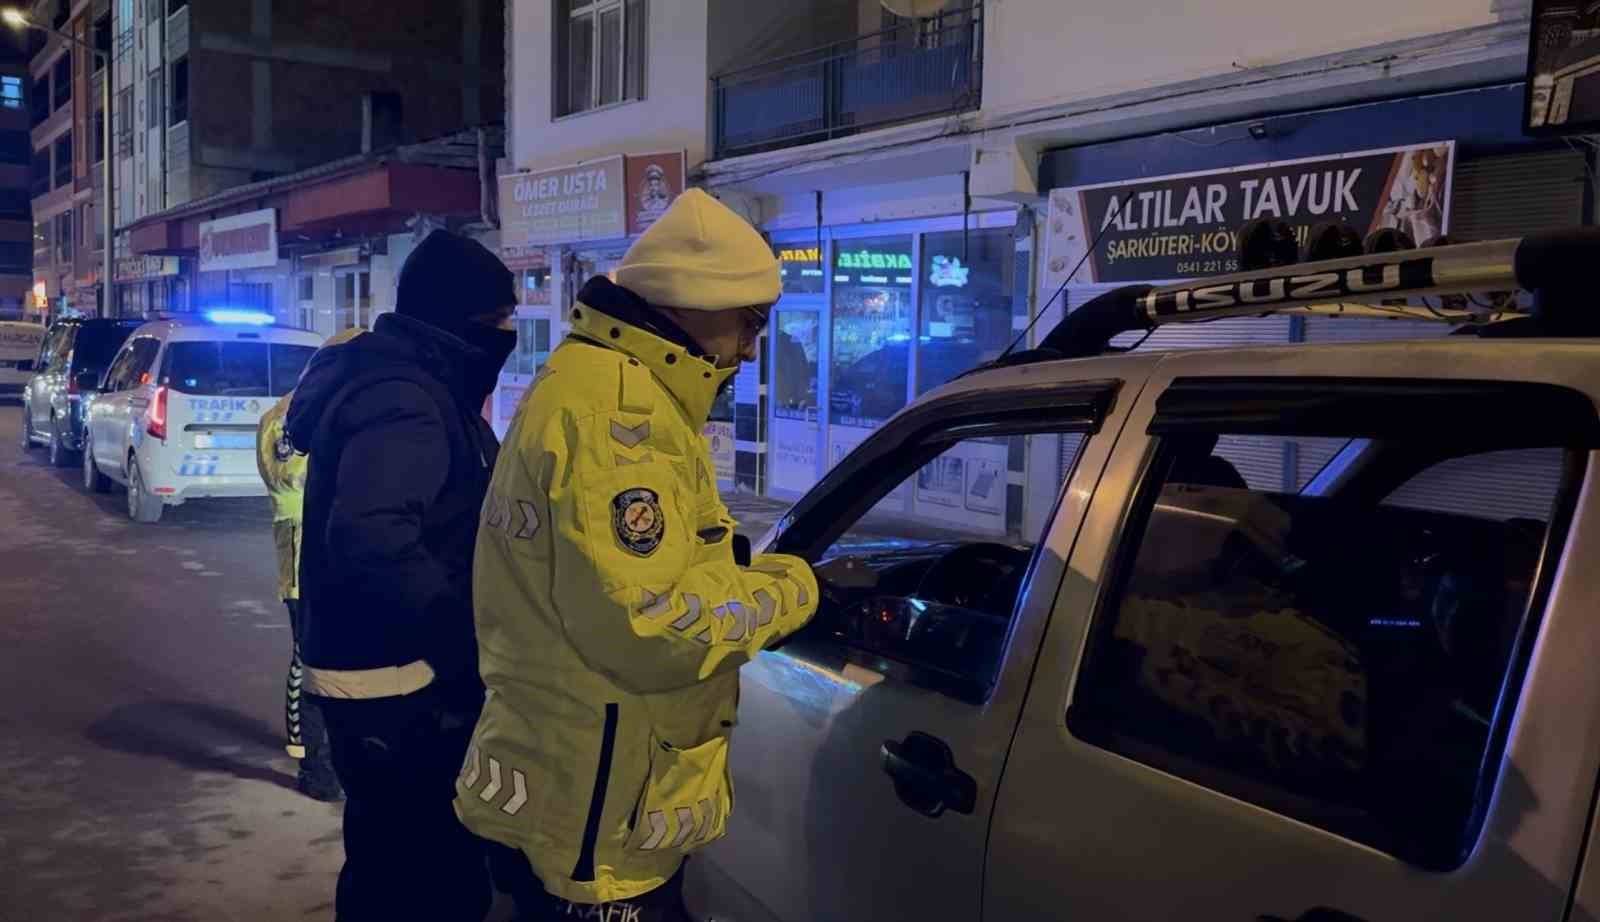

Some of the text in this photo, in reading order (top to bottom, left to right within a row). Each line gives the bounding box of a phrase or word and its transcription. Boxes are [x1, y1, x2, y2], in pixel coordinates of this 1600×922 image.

[514, 171, 607, 202] ÖMER USTA
[1102, 168, 1363, 231] ALTILAR TAVUK
[1177, 259, 1239, 273] 0541 221 55
